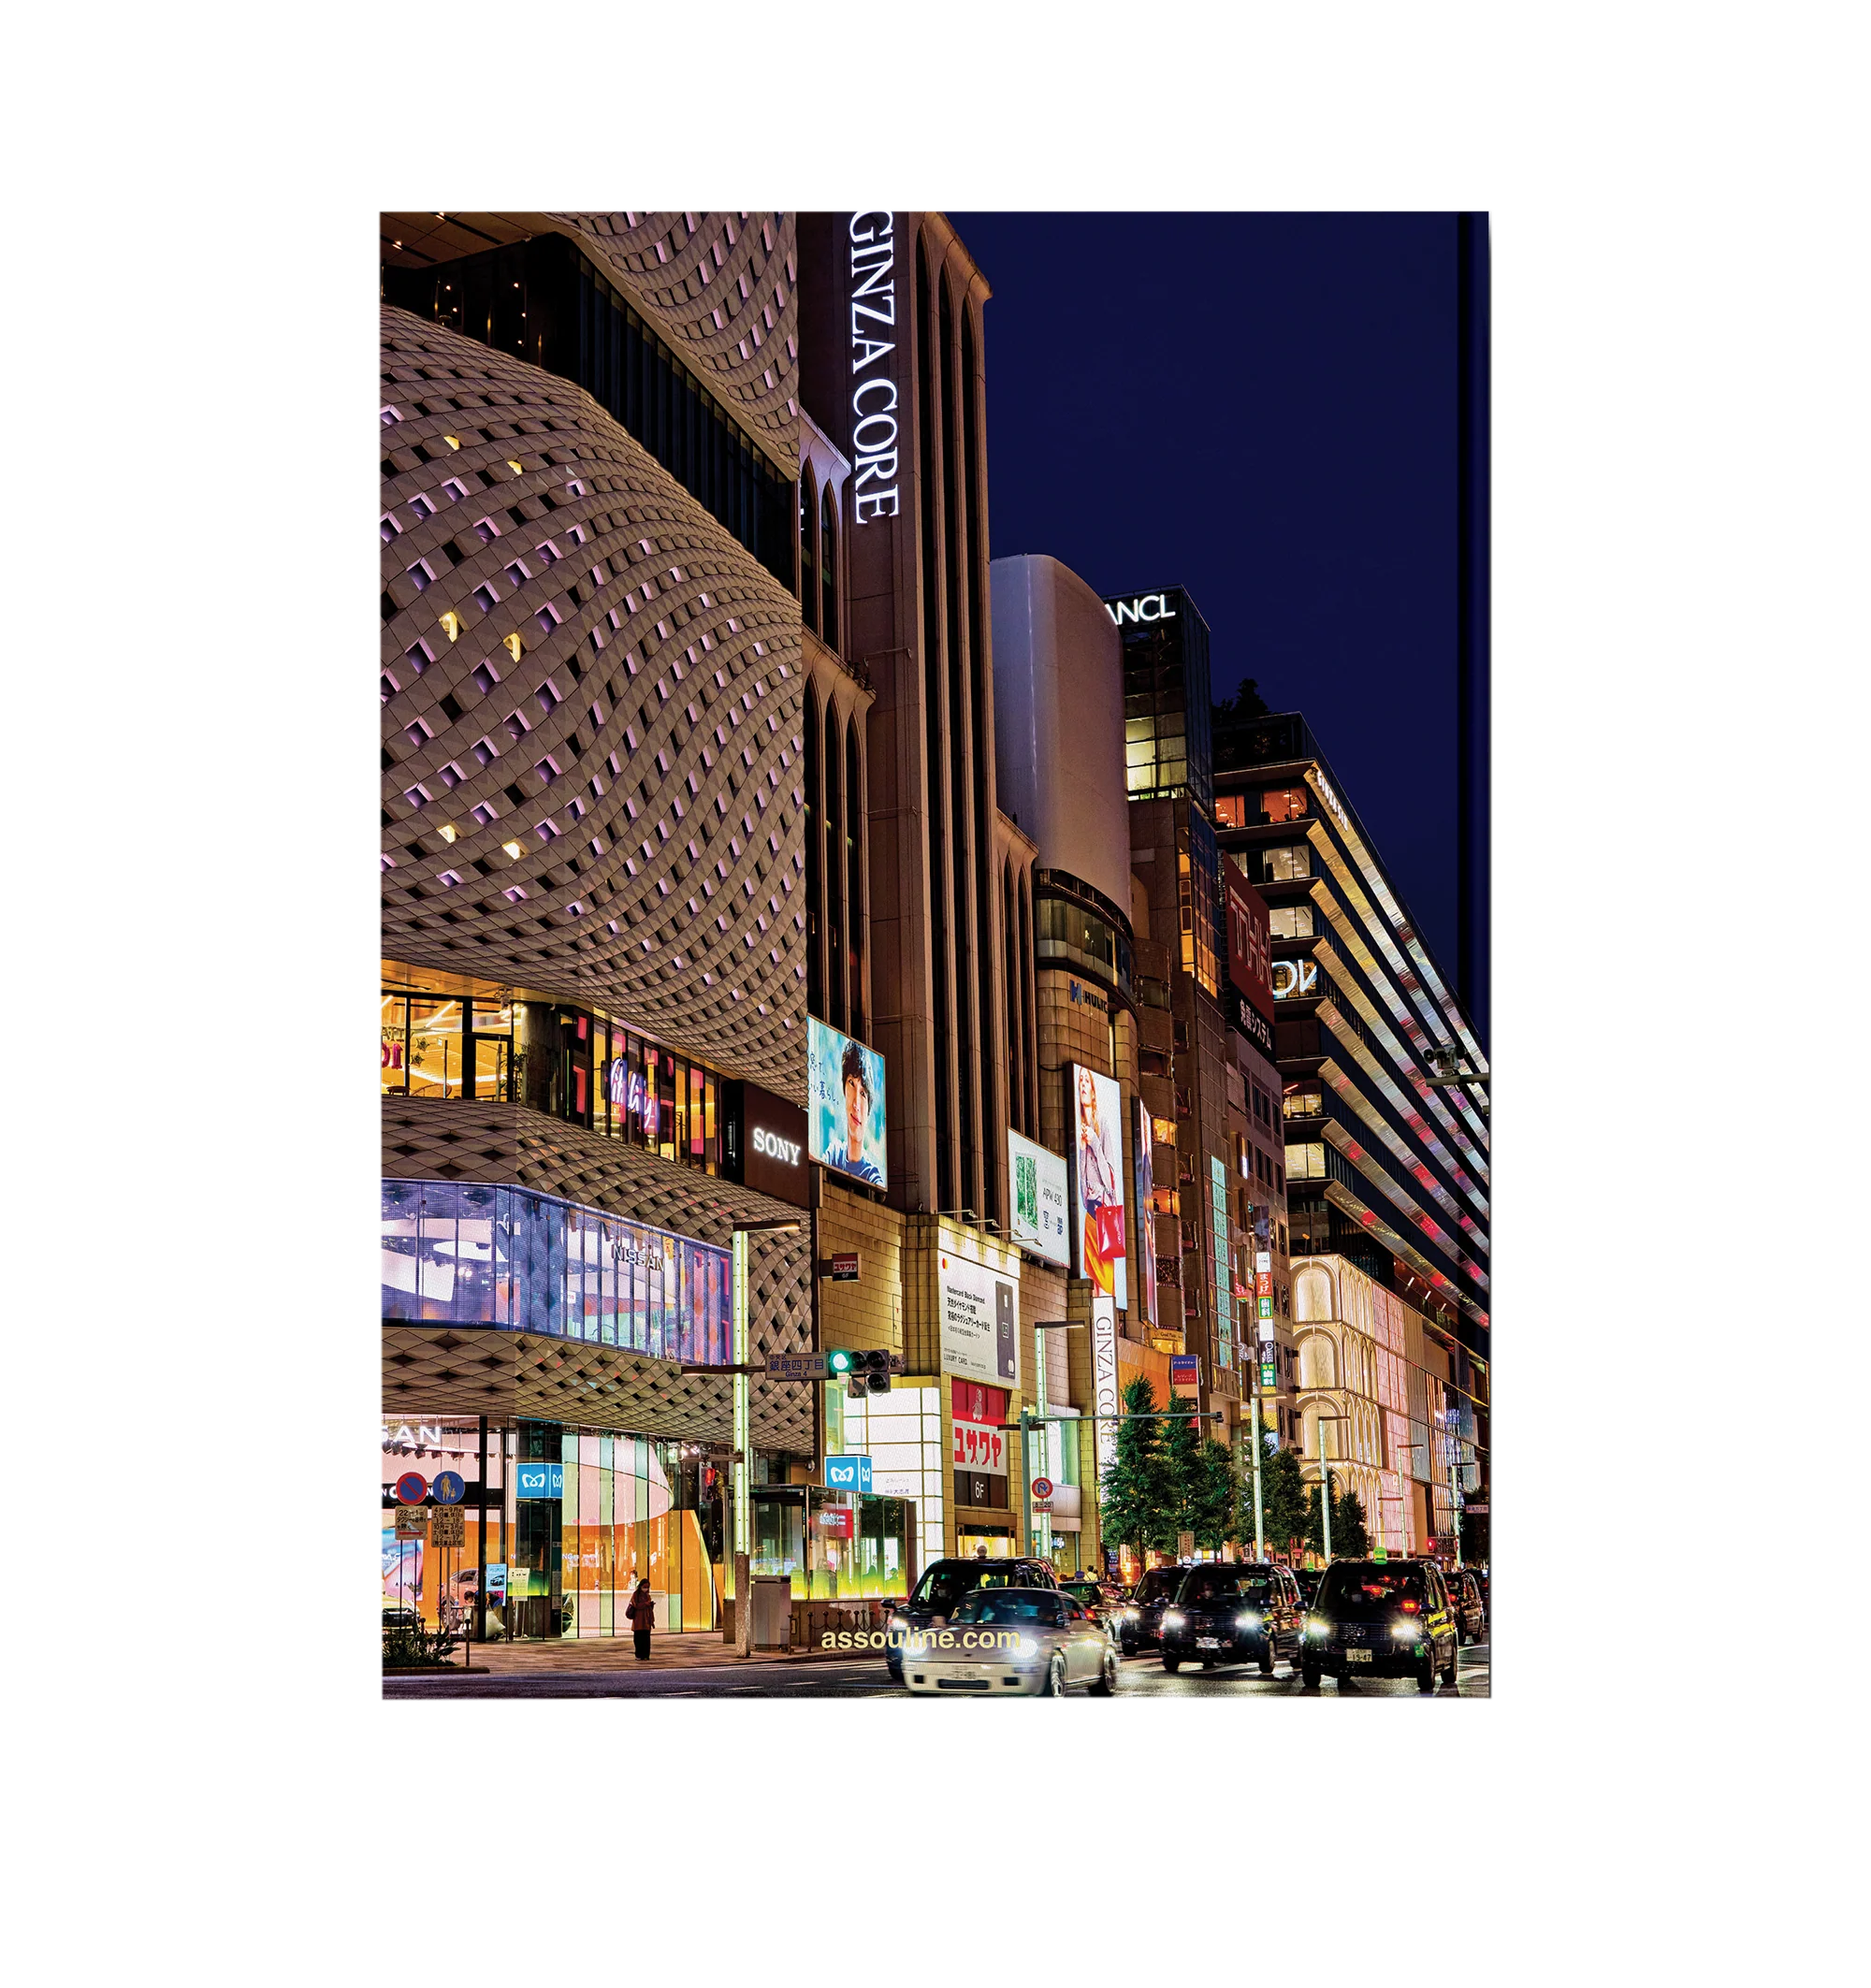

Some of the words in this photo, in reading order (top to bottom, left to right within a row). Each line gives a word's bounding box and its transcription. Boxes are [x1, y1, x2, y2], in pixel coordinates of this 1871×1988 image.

[849, 210, 895, 374] GINZA
[853, 378, 899, 524] CORE
[1228, 885, 1273, 995] THK
[753, 1126, 801, 1167] SONY
[611, 1243, 664, 1271] NISSAN
[769, 1358, 824, 1371] 銀座四丁目
[1095, 1315, 1114, 1383] GINZA
[975, 1481, 984, 1499] 6F
